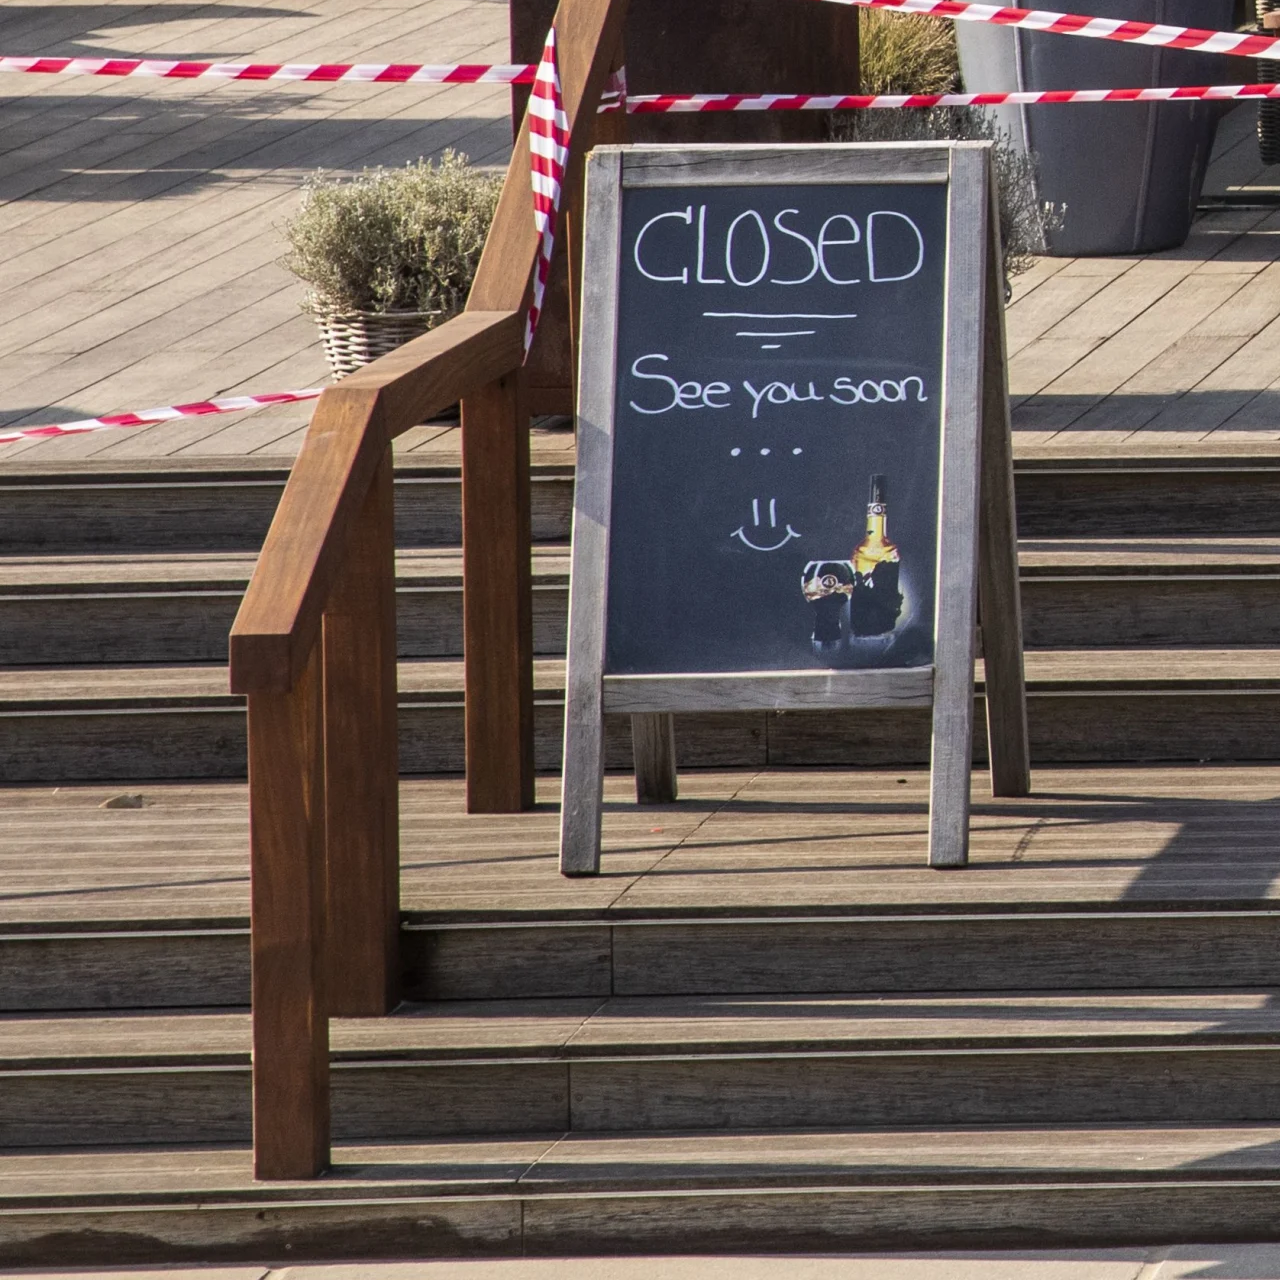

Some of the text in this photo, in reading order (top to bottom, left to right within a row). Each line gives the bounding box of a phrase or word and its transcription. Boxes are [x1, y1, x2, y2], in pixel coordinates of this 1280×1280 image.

[634, 205, 924, 287] CLOSeD
[629, 353, 928, 419] See you soon
